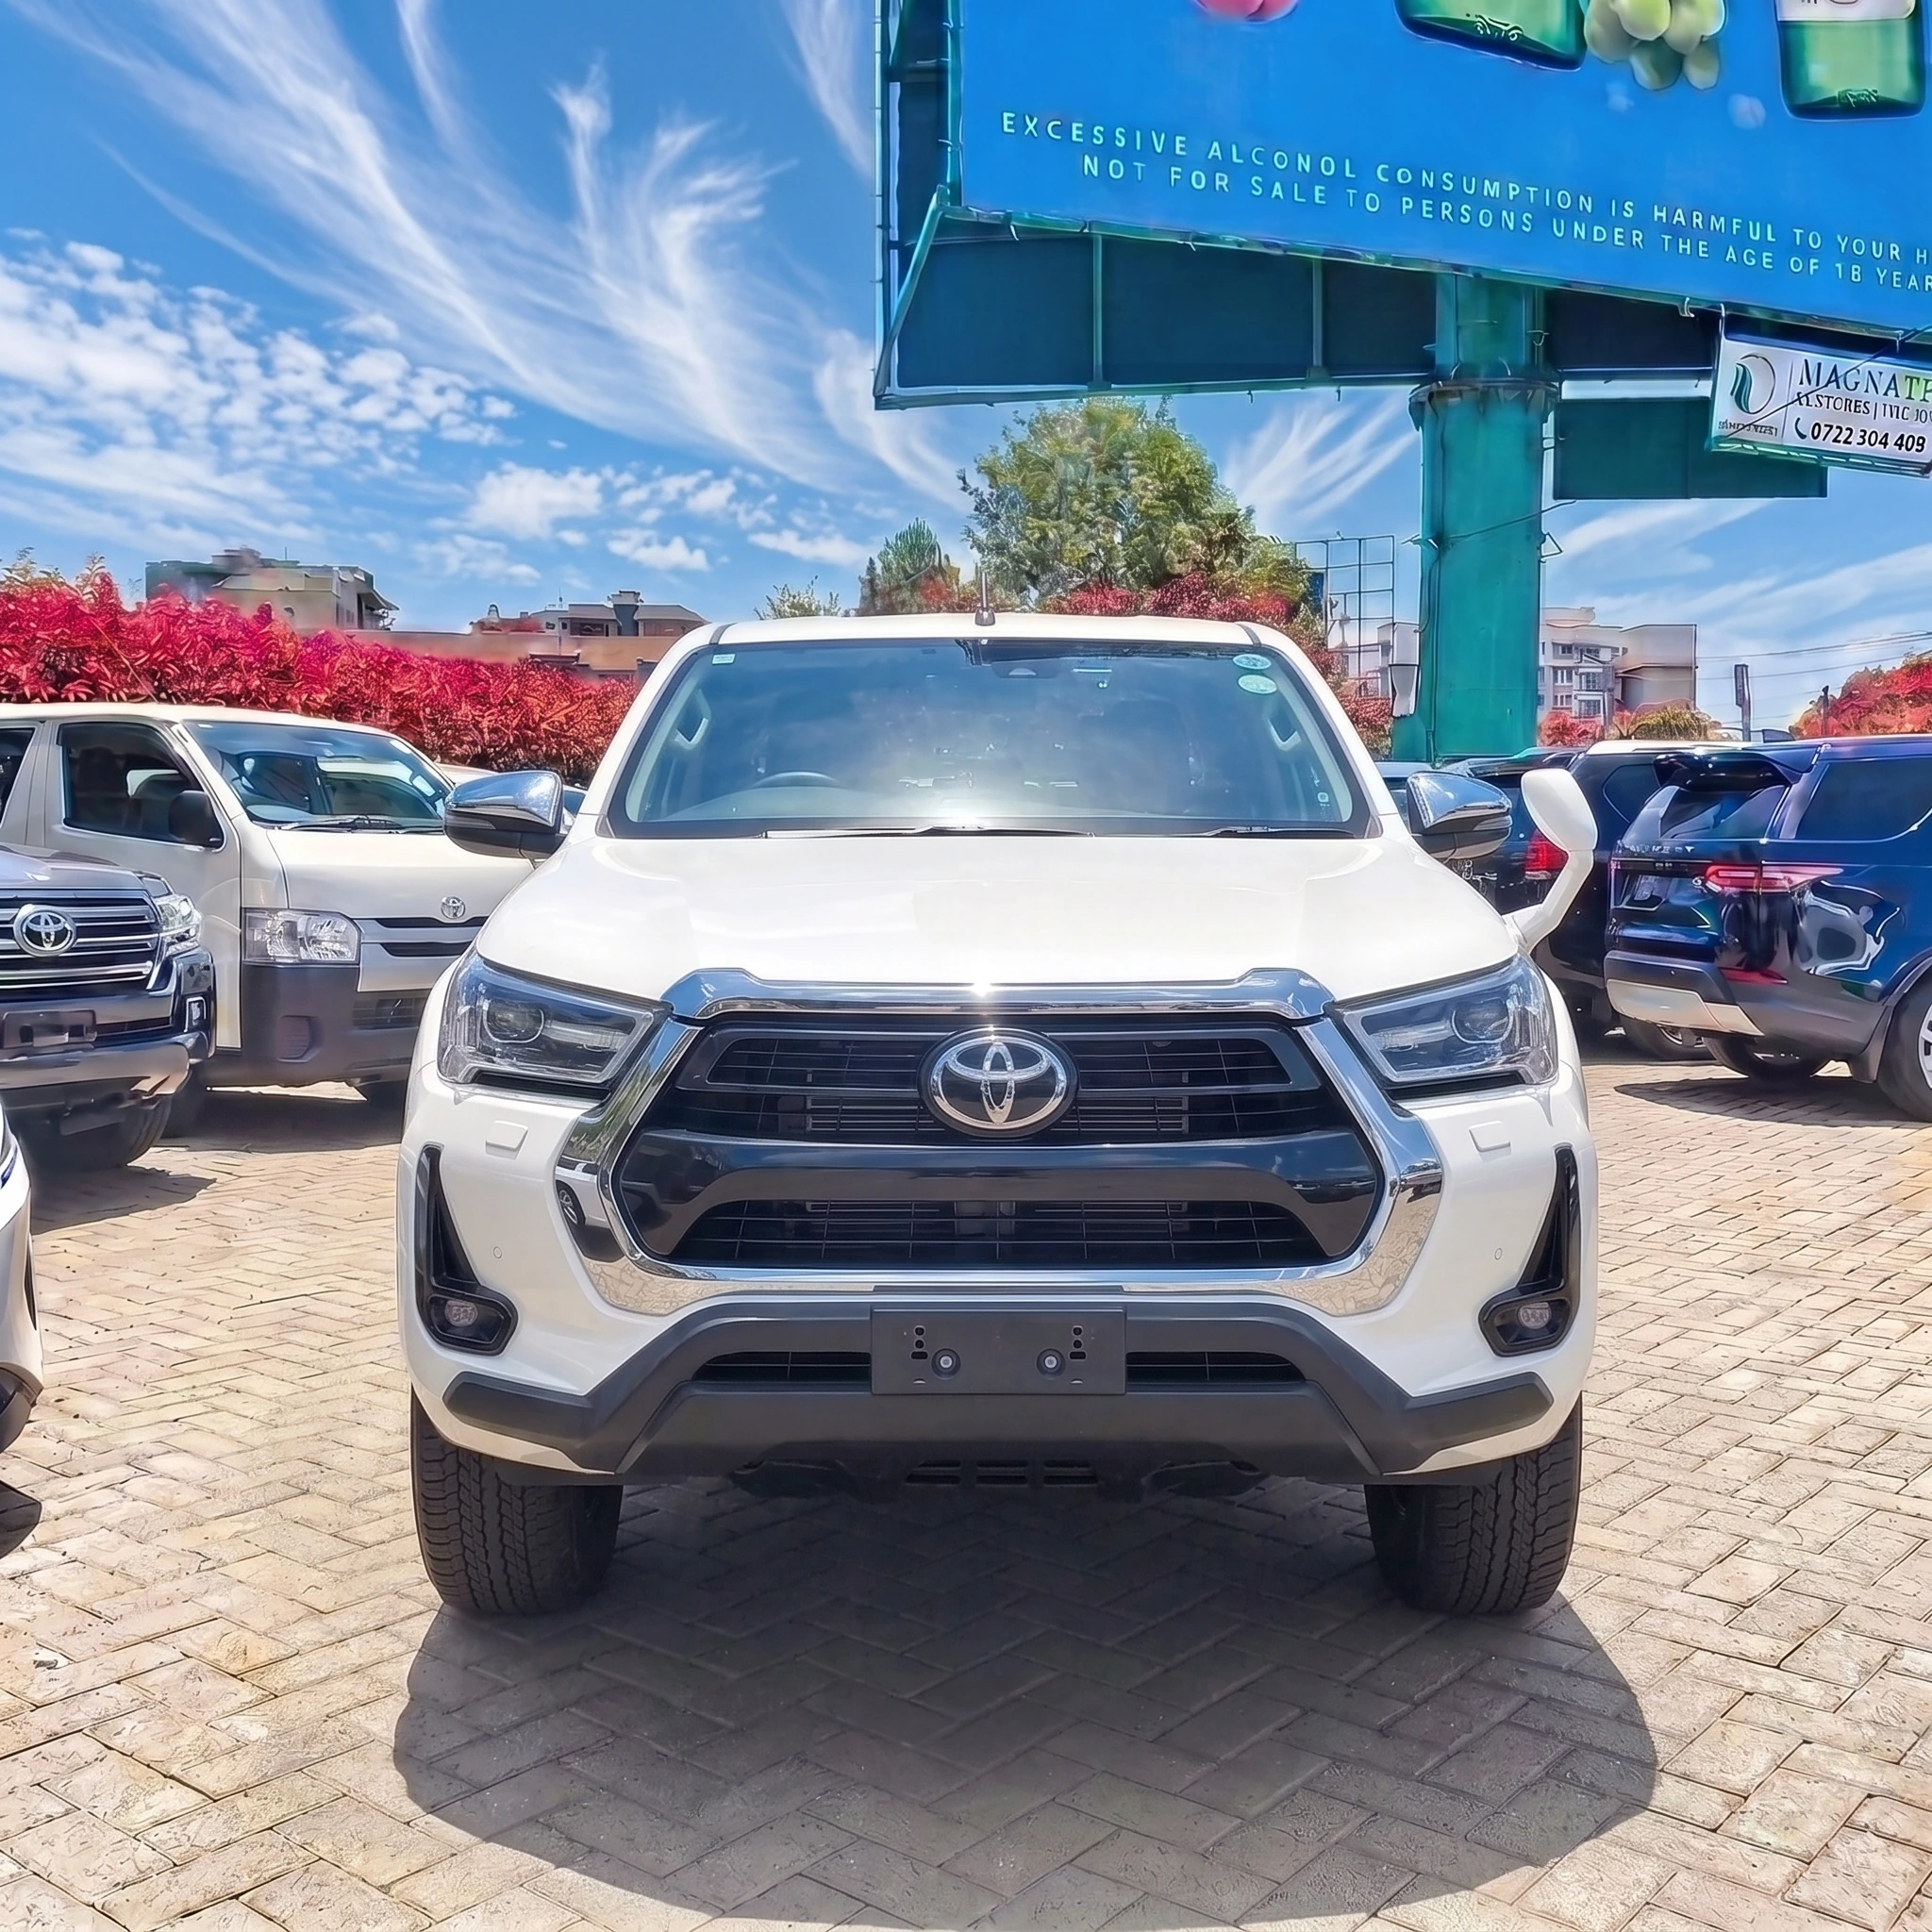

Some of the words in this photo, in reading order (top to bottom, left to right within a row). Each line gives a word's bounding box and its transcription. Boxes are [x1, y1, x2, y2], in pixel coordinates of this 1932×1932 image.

[1003, 111, 1187, 156] EXCESSIVE
[1376, 164, 1592, 213] CONSUMPTION
[1611, 199, 1634, 218] IS
[1654, 205, 1776, 242] HARMFUL
[1792, 228, 1822, 249] TO
[1836, 234, 1901, 260] YOUR
[1084, 154, 1146, 180] NOT
[1171, 166, 1229, 192] FOR
[1251, 175, 1326, 205] SALE
[1346, 189, 1380, 212] TO
[1402, 196, 1532, 232] PERSONS
[1553, 218, 1643, 249] UNDER
[1661, 234, 1709, 258] THE
[1725, 245, 1774, 269] AGE
[1790, 257, 1819, 275] OF
[1810, 422, 1853, 445] 0722
[1857, 429, 1890, 449] 304
